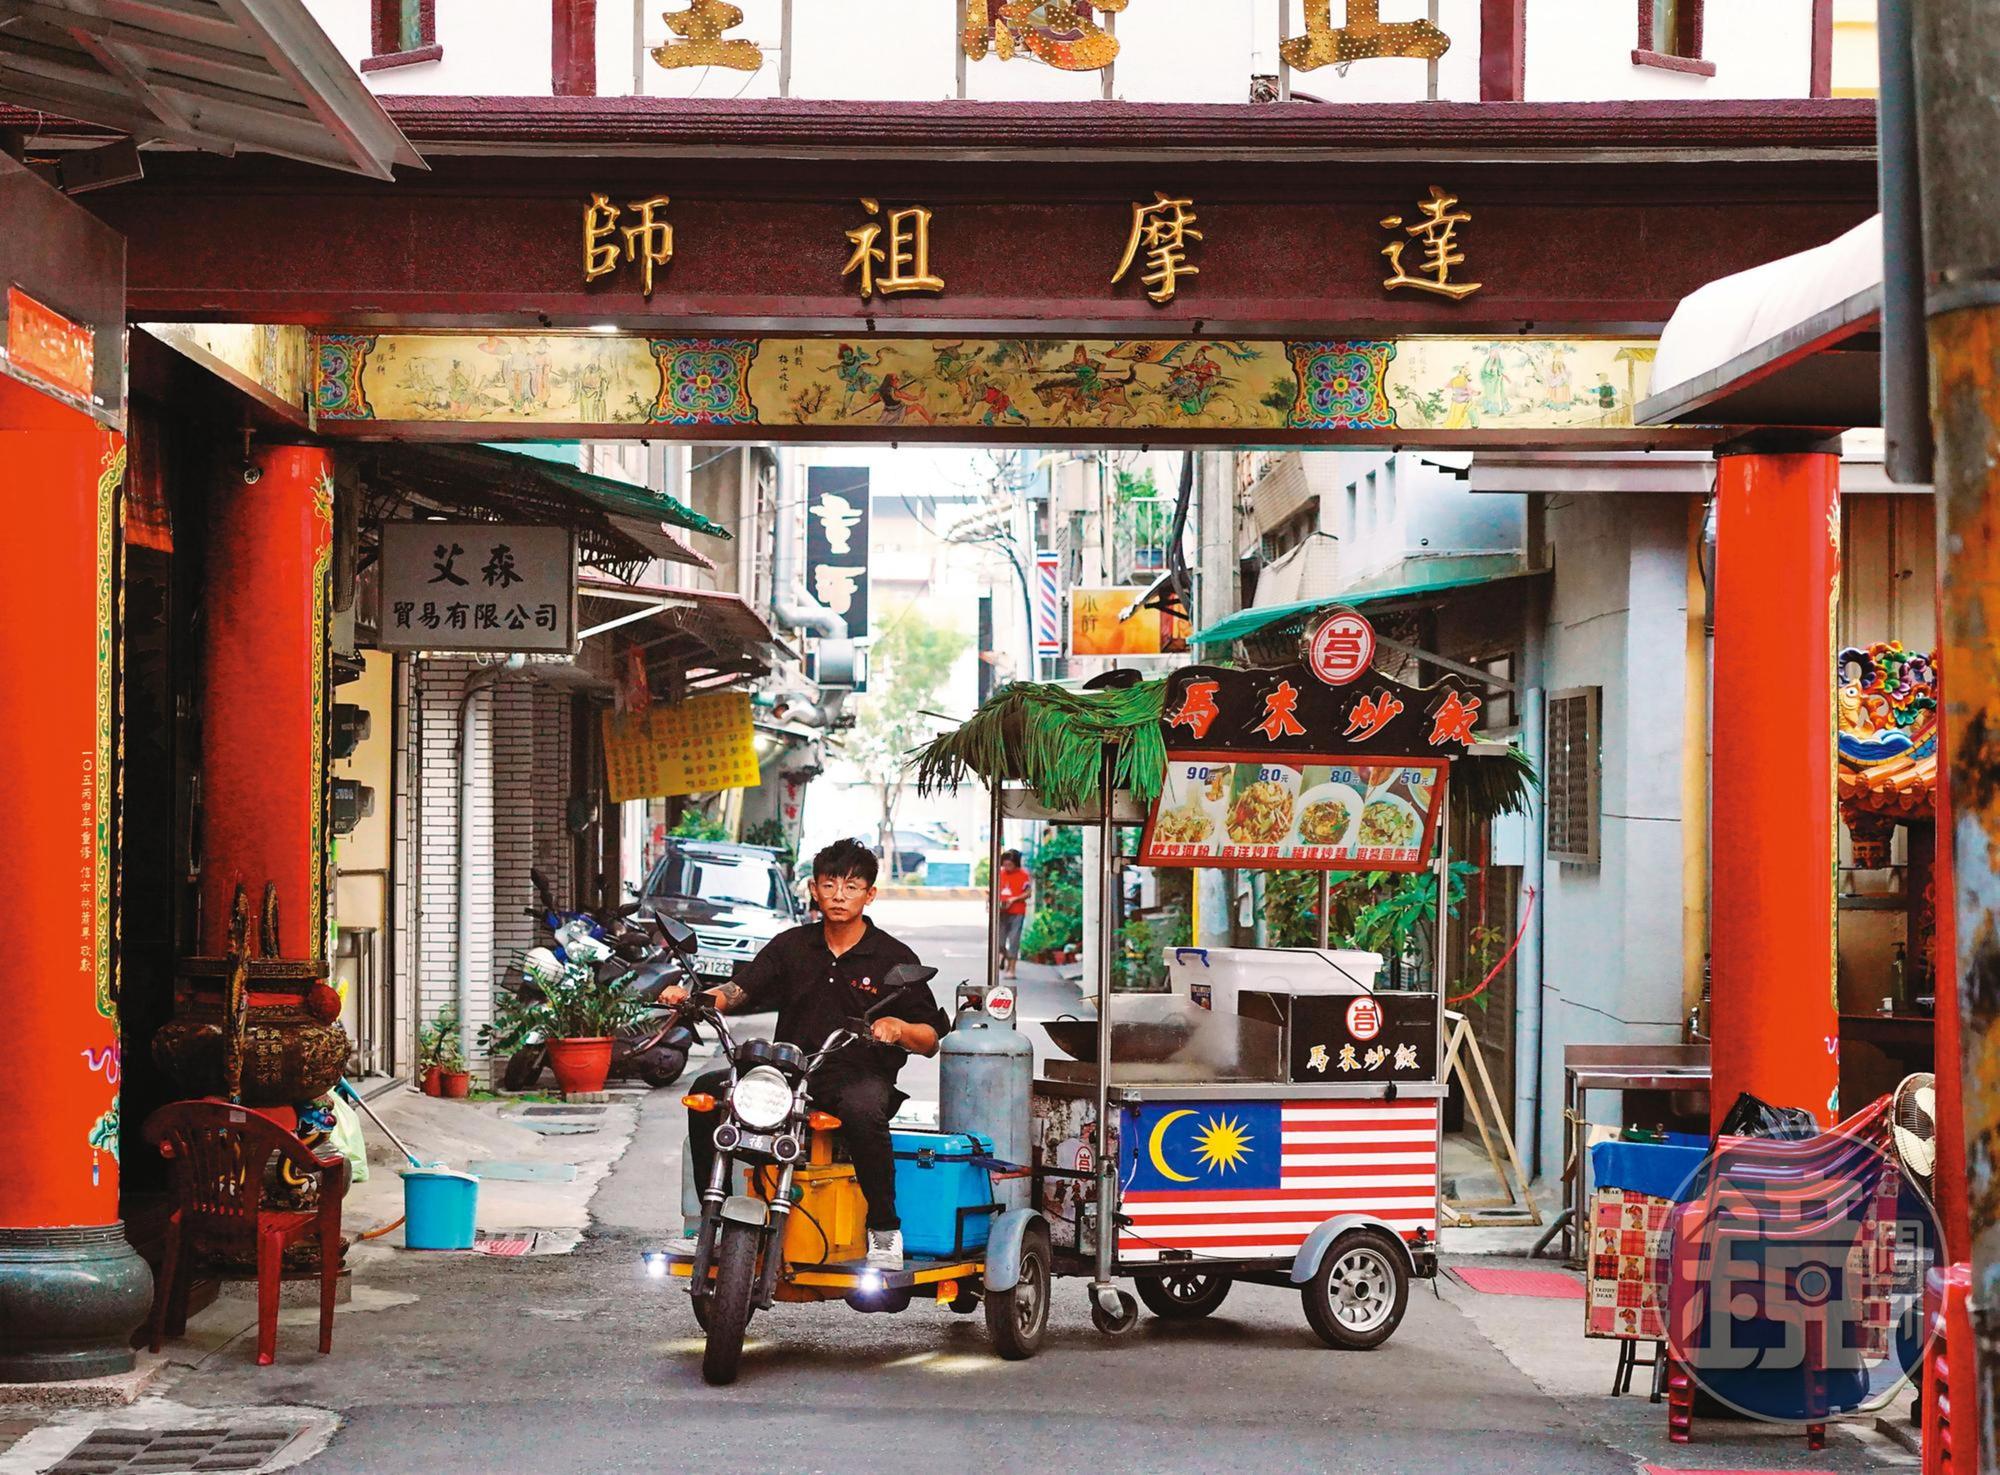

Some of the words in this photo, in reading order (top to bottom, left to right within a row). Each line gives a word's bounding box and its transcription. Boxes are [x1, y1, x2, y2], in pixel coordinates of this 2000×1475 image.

[427, 543, 524, 588] 艾森
[394, 601, 557, 631] 貿易有限公司
[1222, 846, 1280, 858] 南洋炒飯
[1306, 1043, 1420, 1073] 馬來炒飯
